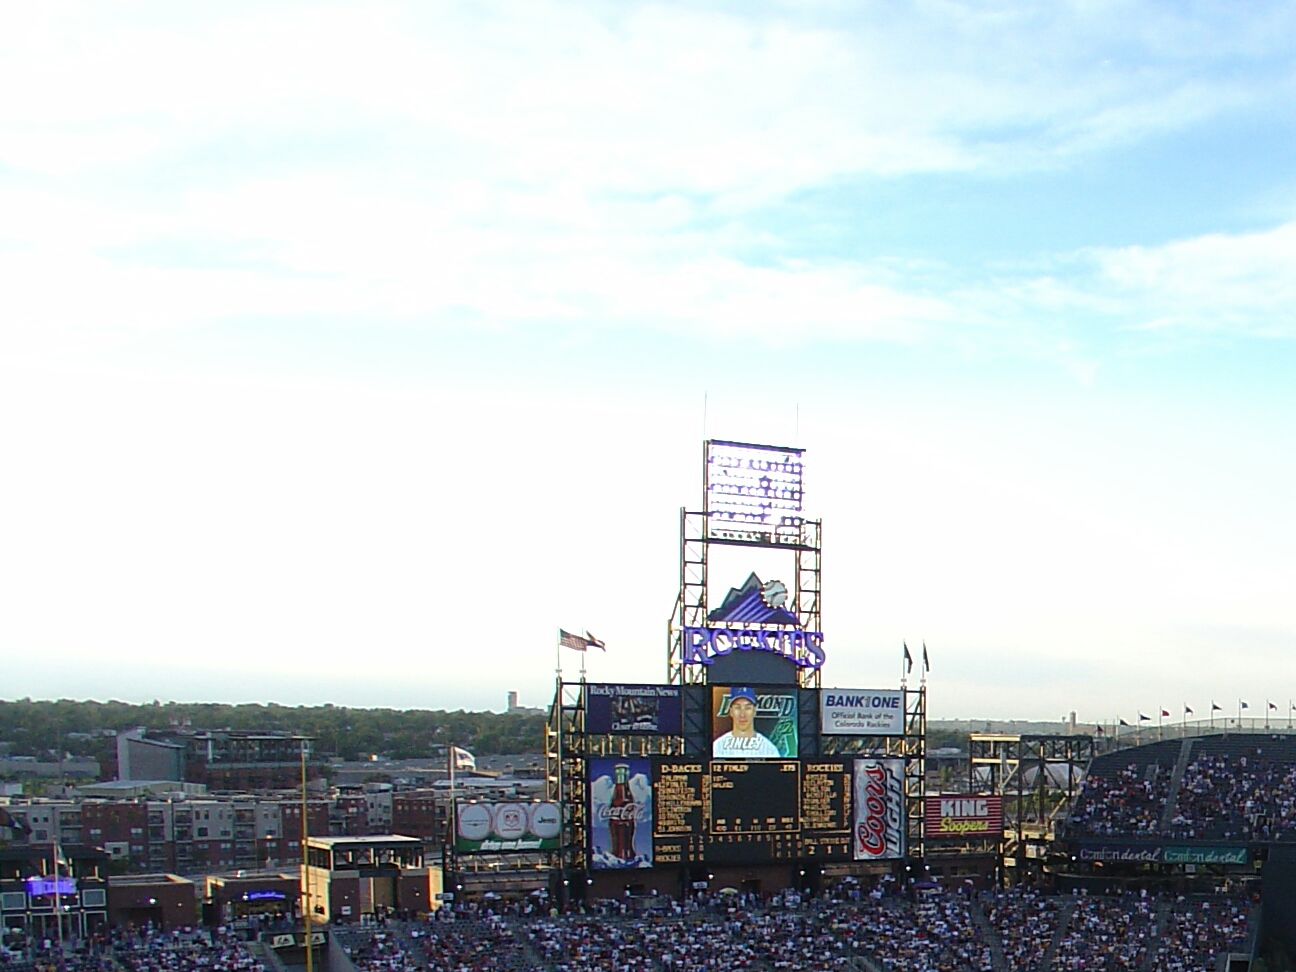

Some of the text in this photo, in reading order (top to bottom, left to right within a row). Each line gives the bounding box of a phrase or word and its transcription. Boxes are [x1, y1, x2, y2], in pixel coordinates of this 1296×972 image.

[683, 626, 826, 668] ROCKIES
[590, 686, 678, 697] Rocky Mountain News
[825, 695, 866, 708] BANK
[872, 696, 900, 709] ONE
[831, 711, 855, 719] Official
[857, 712, 873, 720] Bank
[875, 712, 882, 720] of
[834, 720, 865, 728] Colorado
[723, 737, 763, 750] FINLEY
[661, 765, 702, 773] D-BACKS
[807, 764, 843, 772] ROCKIES
[859, 763, 886, 856] Coors
[885, 767, 902, 855] LIGHT
[940, 800, 988, 817] KING
[939, 817, 989, 836] Soopers
[718, 835, 723, 843] 4
[809, 846, 815, 854] 2
[827, 845, 832, 854] 1
[843, 845, 848, 853] 1
[1121, 847, 1161, 861] dental
[1205, 848, 1246, 863] dental
